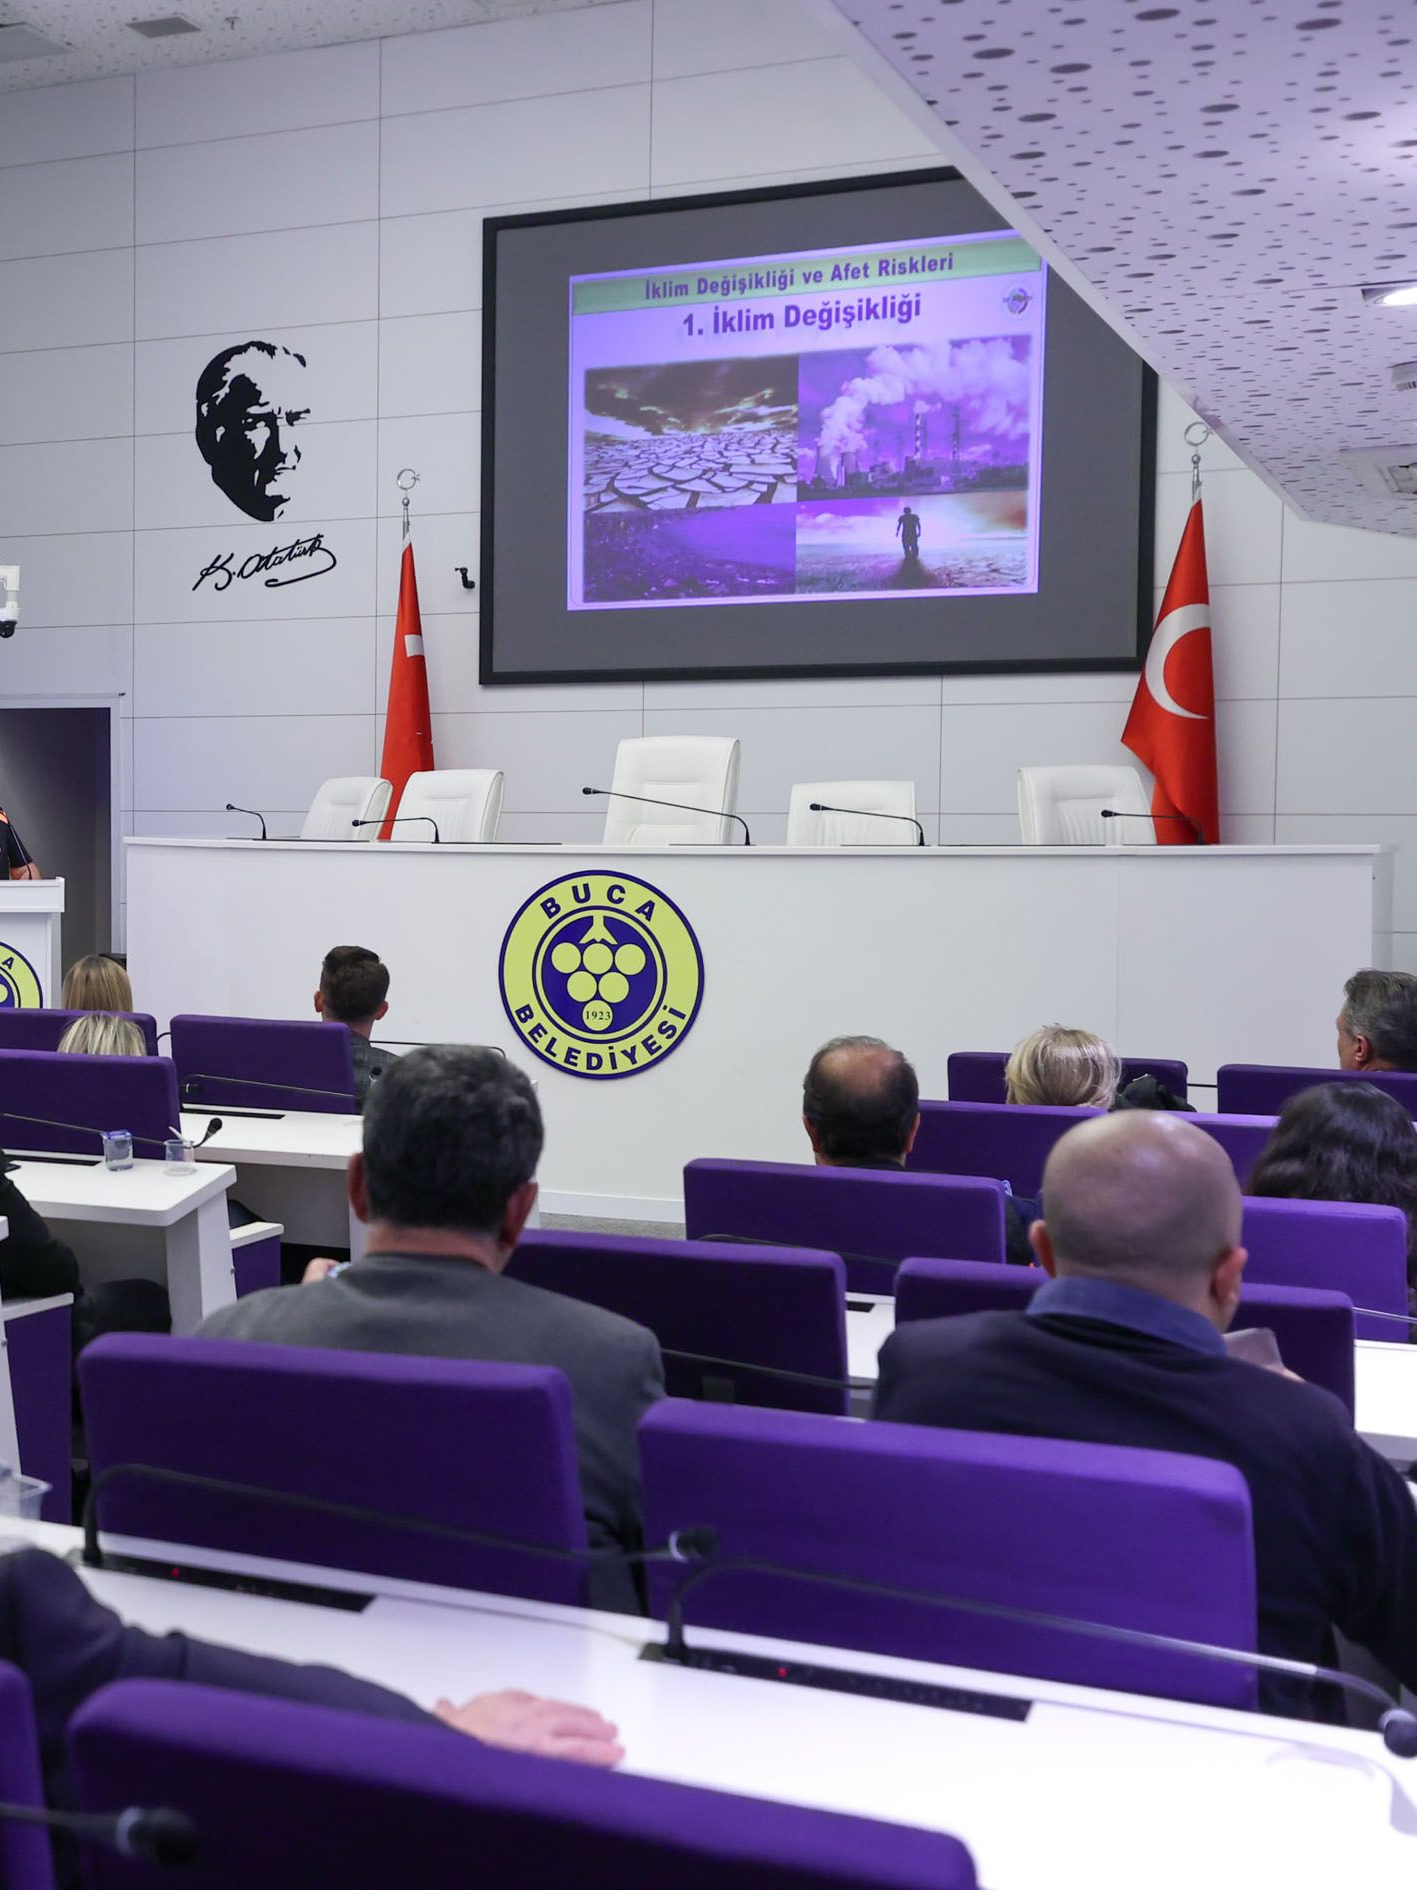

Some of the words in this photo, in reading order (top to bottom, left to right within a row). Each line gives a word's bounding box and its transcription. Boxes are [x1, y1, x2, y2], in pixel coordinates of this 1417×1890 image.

[645, 279, 689, 300] İklim
[697, 269, 794, 297] Değişikliği
[802, 270, 823, 285] ve
[830, 262, 870, 282] Afet
[878, 253, 954, 277] Riskleri
[683, 313, 704, 336] 1.
[713, 305, 775, 335] İklim
[784, 293, 921, 331] Değişikliği
[540, 883, 656, 922] BUCA
[585, 1010, 611, 1021] 1923
[515, 1004, 687, 1071] BELEDİYESİ
